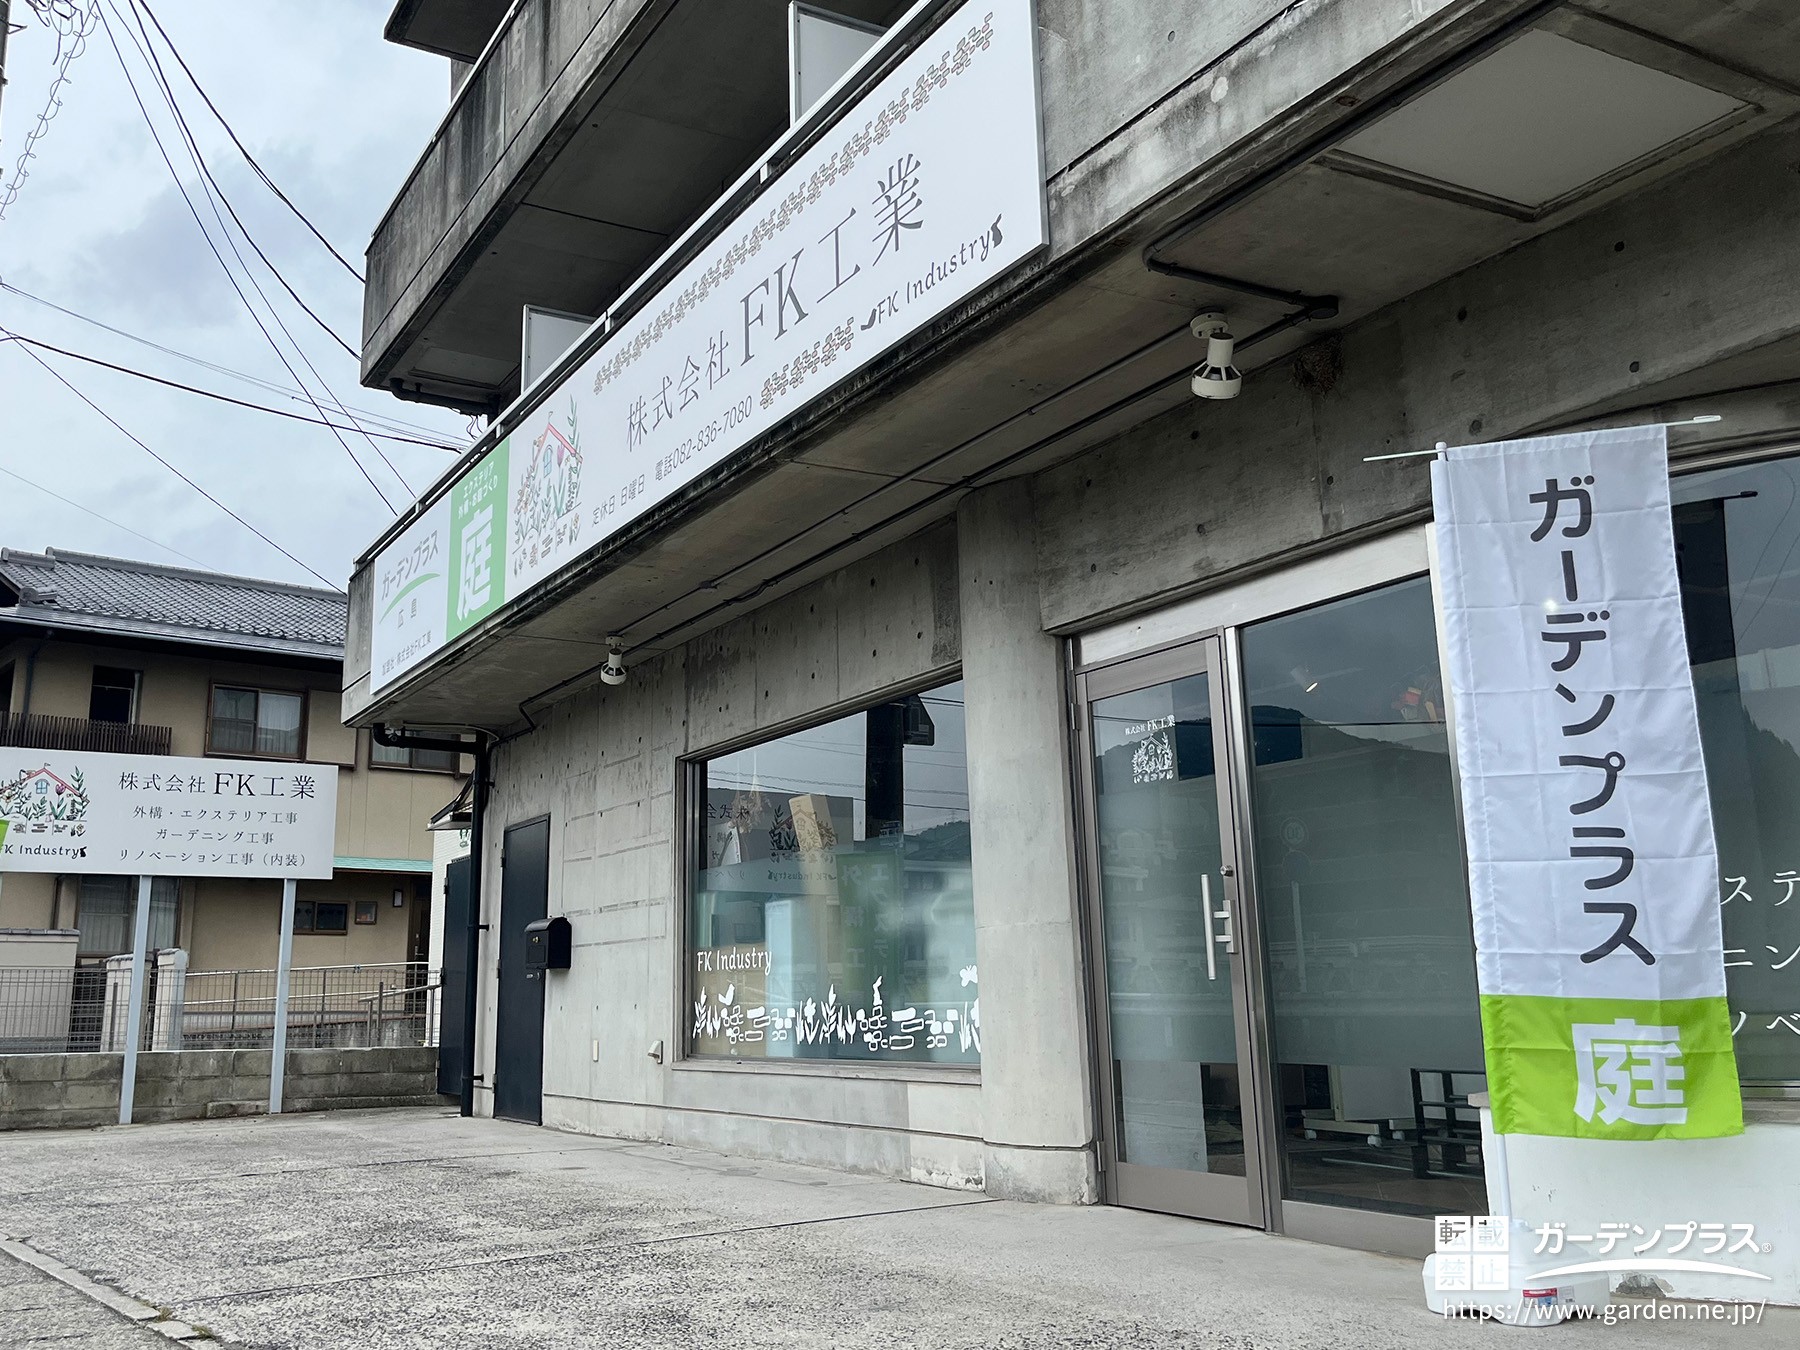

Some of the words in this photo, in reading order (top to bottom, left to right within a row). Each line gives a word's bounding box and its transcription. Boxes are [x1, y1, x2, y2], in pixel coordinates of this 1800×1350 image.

[625, 152, 924, 453] 株式会社FK工業
[876, 290, 899, 324] FK
[905, 230, 991, 304] Industry
[591, 494, 615, 528] 定休日
[620, 473, 645, 507] 日曜日
[381, 529, 440, 601] ガーデンプラス
[456, 503, 494, 622] 庭
[1529, 474, 1656, 967] ガーデンプラス
[118, 770, 316, 800] 株式会社FK工業
[132, 805, 298, 825] 外構・エクステリア工事
[19, 843, 80, 860] Industry
[155, 828, 275, 845] ガーデニング工事
[696, 950, 713, 973] FK
[716, 947, 773, 976] Industry
[1570, 1017, 1688, 1127] 庭
